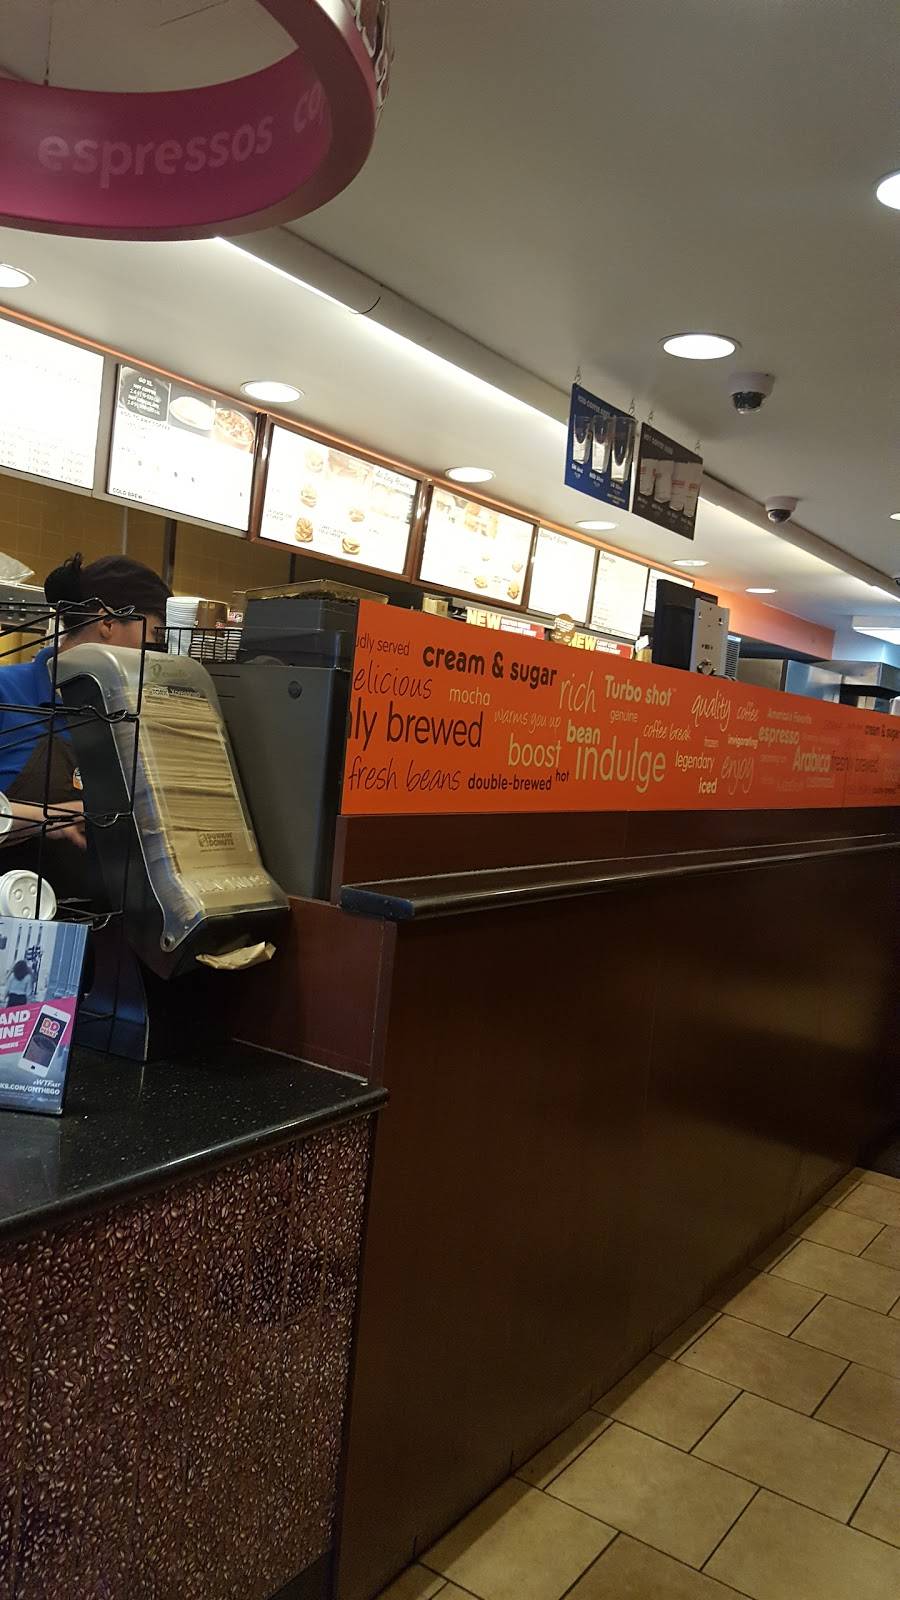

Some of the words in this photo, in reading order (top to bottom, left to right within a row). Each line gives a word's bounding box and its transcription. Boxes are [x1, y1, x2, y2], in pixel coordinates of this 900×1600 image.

[37, 115, 274, 190] espressos
[465, 608, 502, 631] NEW
[376, 639, 410, 656] served
[353, 660, 432, 700] elicious
[423, 646, 485, 676] cream
[491, 652, 504, 679] &
[510, 661, 557, 690] sugar
[449, 687, 491, 706] mocha
[559, 670, 596, 713] rich
[605, 674, 643, 703] Turbo
[645, 683, 673, 707] shot
[386, 700, 484, 748] brewed
[494, 708, 528, 725] warms
[529, 713, 547, 734] you
[547, 716, 561, 729] up
[610, 708, 638, 724] genuine
[691, 690, 732, 733] quality
[736, 701, 760, 723] coffee
[567, 720, 601, 745] bean
[643, 720, 668, 739] coffee
[669, 723, 691, 741] break
[758, 724, 800, 746] espresso
[508, 733, 562, 768] boost
[675, 752, 715, 773] legendary
[792, 747, 831, 773] Arabica
[348, 755, 398, 792] fresh
[406, 760, 461, 792] beans
[555, 769, 570, 783] hot
[575, 737, 666, 794] indulge
[721, 755, 754, 795] enjoy
[468, 773, 552, 791] double-brewed
[698, 777, 718, 795] iced
[0, 1009, 31, 1025] AND
